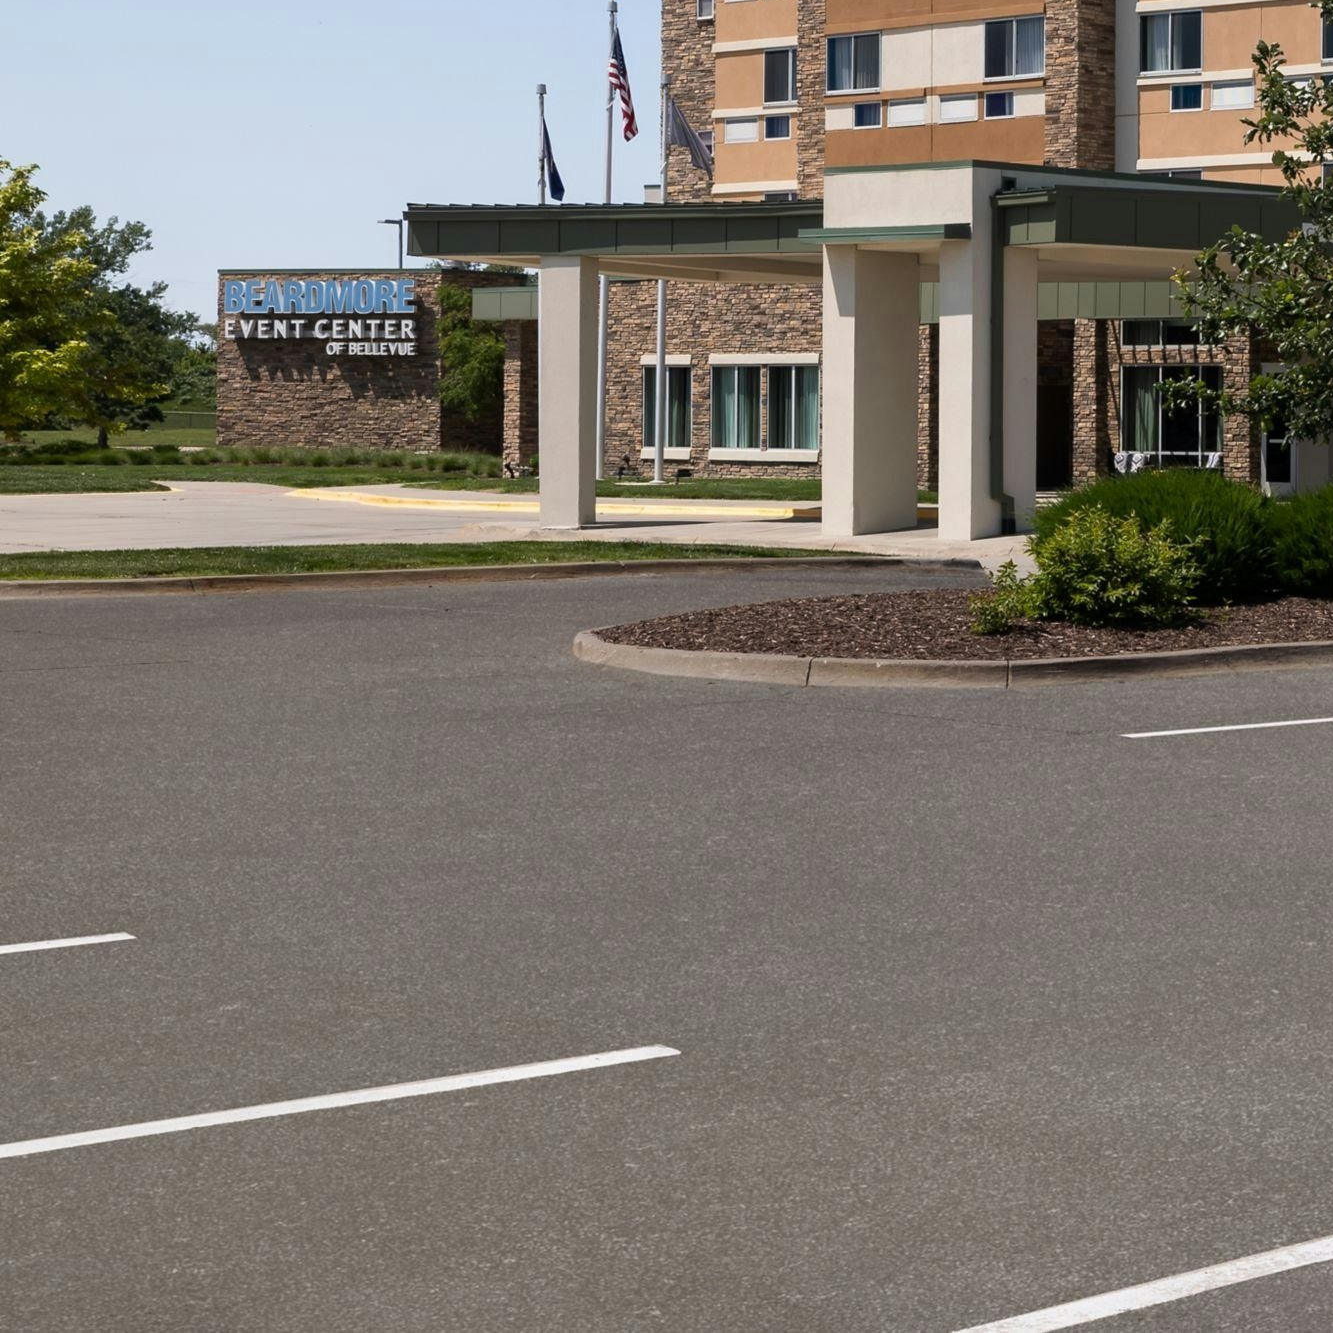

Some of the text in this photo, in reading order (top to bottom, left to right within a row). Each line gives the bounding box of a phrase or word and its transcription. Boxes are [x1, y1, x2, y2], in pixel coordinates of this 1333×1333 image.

[224, 279, 417, 314] BEARDMORE
[224, 319, 416, 339] EVENT CENTER
[326, 342, 415, 356] OF BELLEVUE
